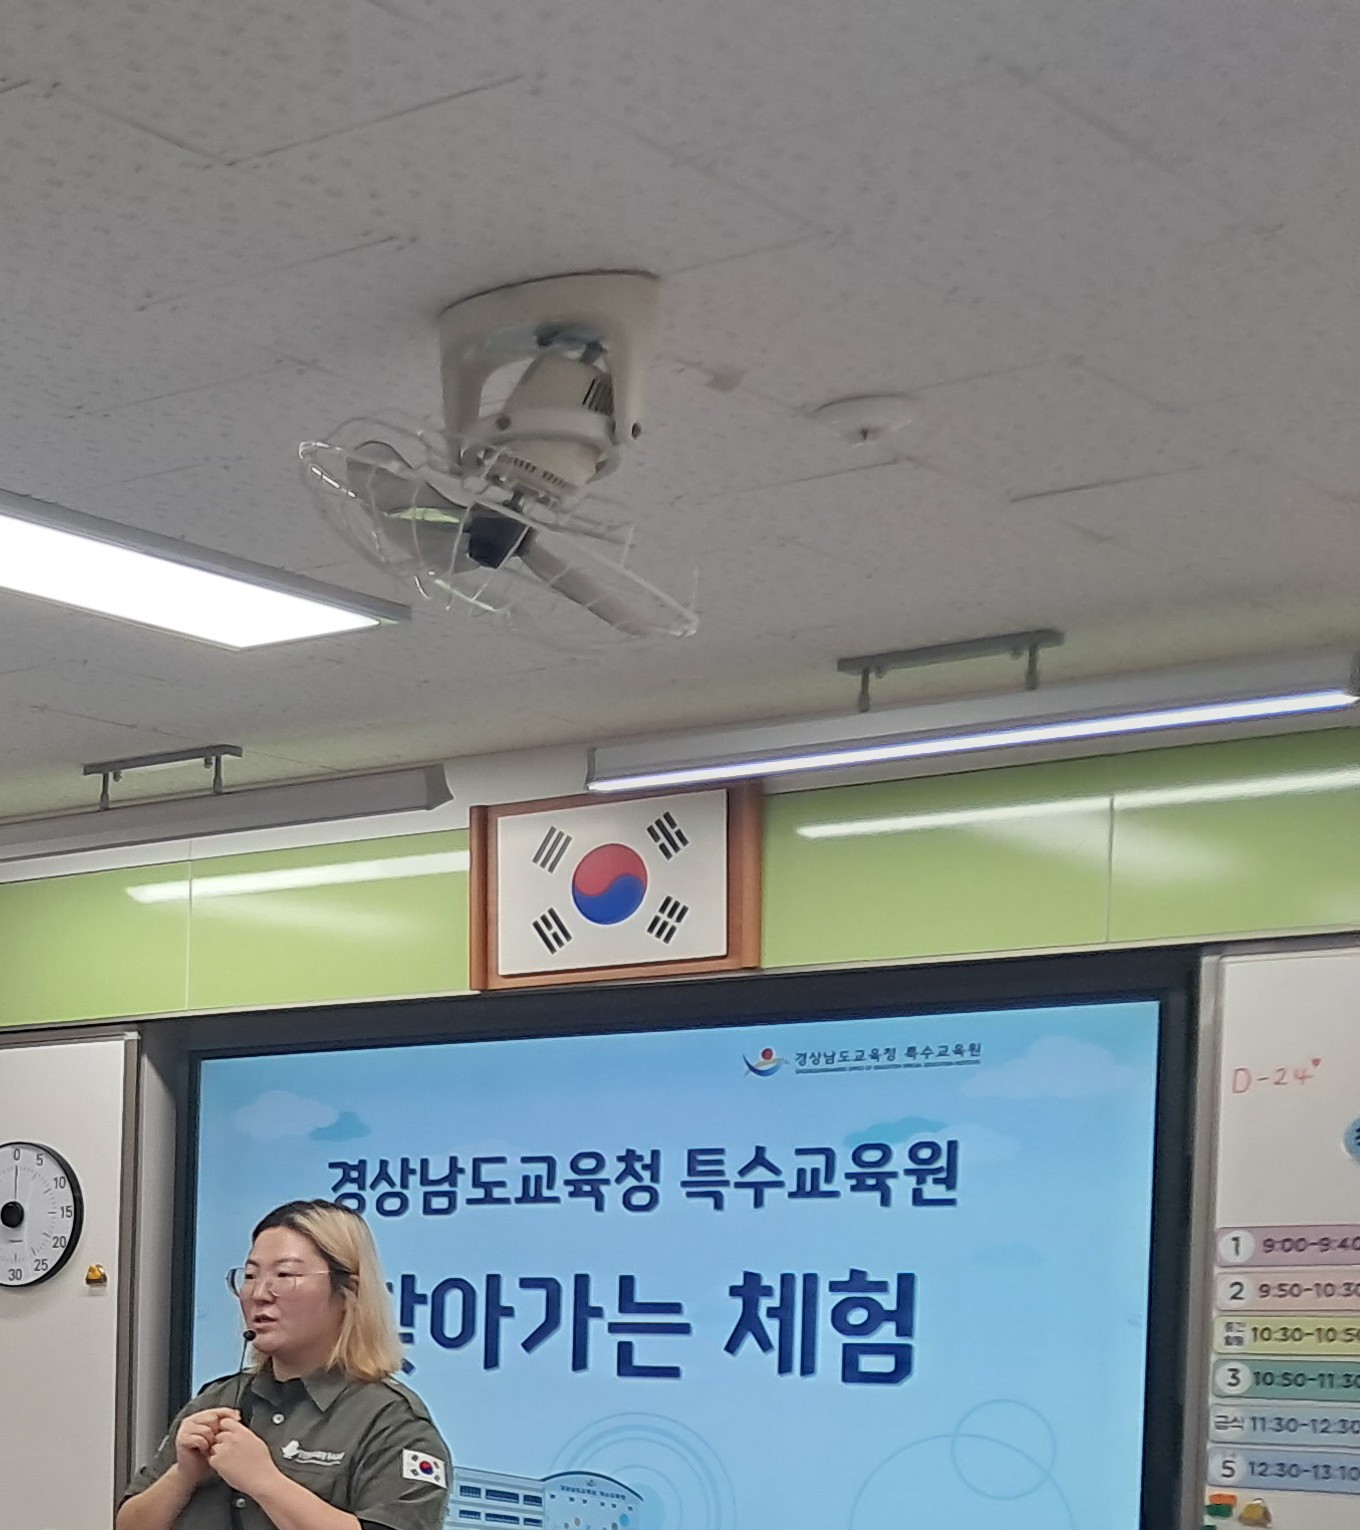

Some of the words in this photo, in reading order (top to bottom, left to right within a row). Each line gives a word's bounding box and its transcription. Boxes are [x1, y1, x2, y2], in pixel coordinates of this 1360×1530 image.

[795, 1047, 897, 1067] 경상남도교육청
[903, 1042, 982, 1060] 특수교육원
[1231, 1066, 1314, 1095] D-24
[13, 1148, 21, 1161] 0
[36, 1153, 44, 1166] 5
[53, 1176, 67, 1190] 10
[328, 1149, 661, 1217] 경상남도교육청
[680, 1140, 958, 1211] 특수교육원
[59, 1205, 73, 1218] 15
[52, 1236, 67, 1249] 20
[1231, 1236, 1240, 1256] 1
[34, 1258, 49, 1272] 25
[8, 1268, 23, 1282] 30
[1230, 1281, 1244, 1301] 2
[386, 1273, 692, 1379] 아가는
[723, 1268, 916, 1384] 체험
[1226, 1368, 1240, 1387] 3
[1221, 1460, 1235, 1478] 5
